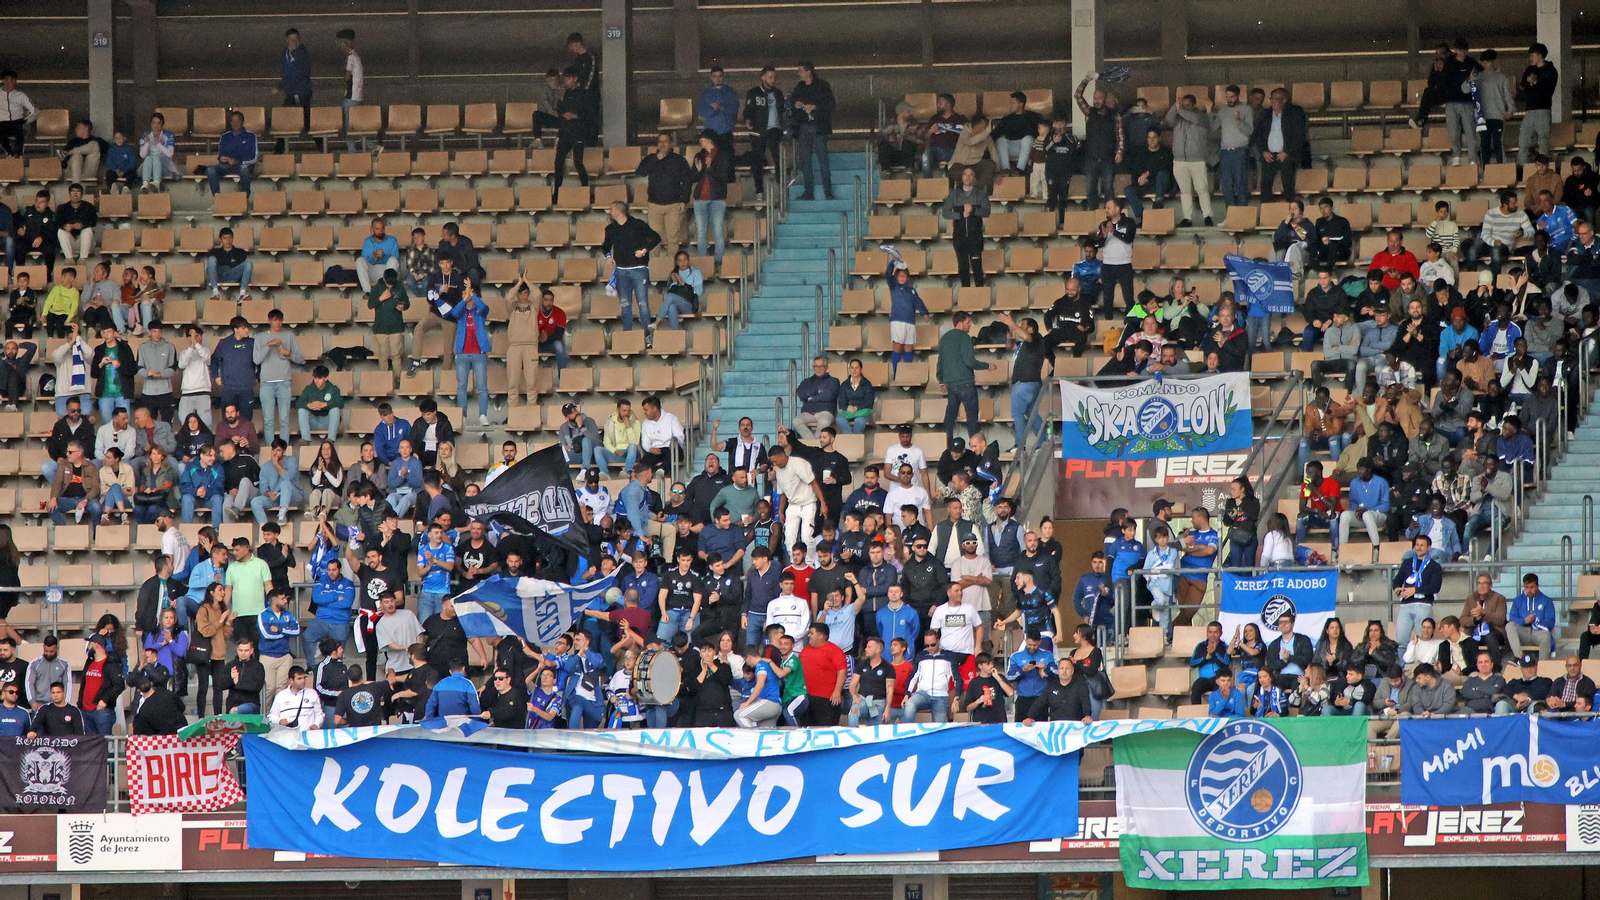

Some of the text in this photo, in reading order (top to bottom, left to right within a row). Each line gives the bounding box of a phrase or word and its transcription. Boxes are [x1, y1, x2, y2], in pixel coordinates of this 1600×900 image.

[93, 37, 108, 46] 319
[607, 29, 621, 38] 319
[1113, 384, 1200, 401] KOMANDO
[1065, 453, 1249, 488] PLAY JEREZ
[1234, 578, 1327, 591] XEREZ TE ADOBO
[1222, 723, 1266, 738] 1911
[1422, 727, 1486, 782] MAMI
[145, 751, 220, 799] BIRIS
[1216, 748, 1269, 816] XEREZ
[1289, 776, 1298, 786] C
[1191, 779, 1198, 788] F
[310, 745, 1014, 849] KOLECTIVO SUR
[1198, 806, 1289, 838] DEPORTIVO
[1404, 806, 1524, 846] JEREZ
[100, 834, 170, 844] Ayuntamiento
[1443, 835, 1481, 843] EXPLORA,
[1526, 834, 1560, 842] COMPITE.
[114, 845, 140, 854] Jerez
[1137, 846, 1359, 881] XEREZ
